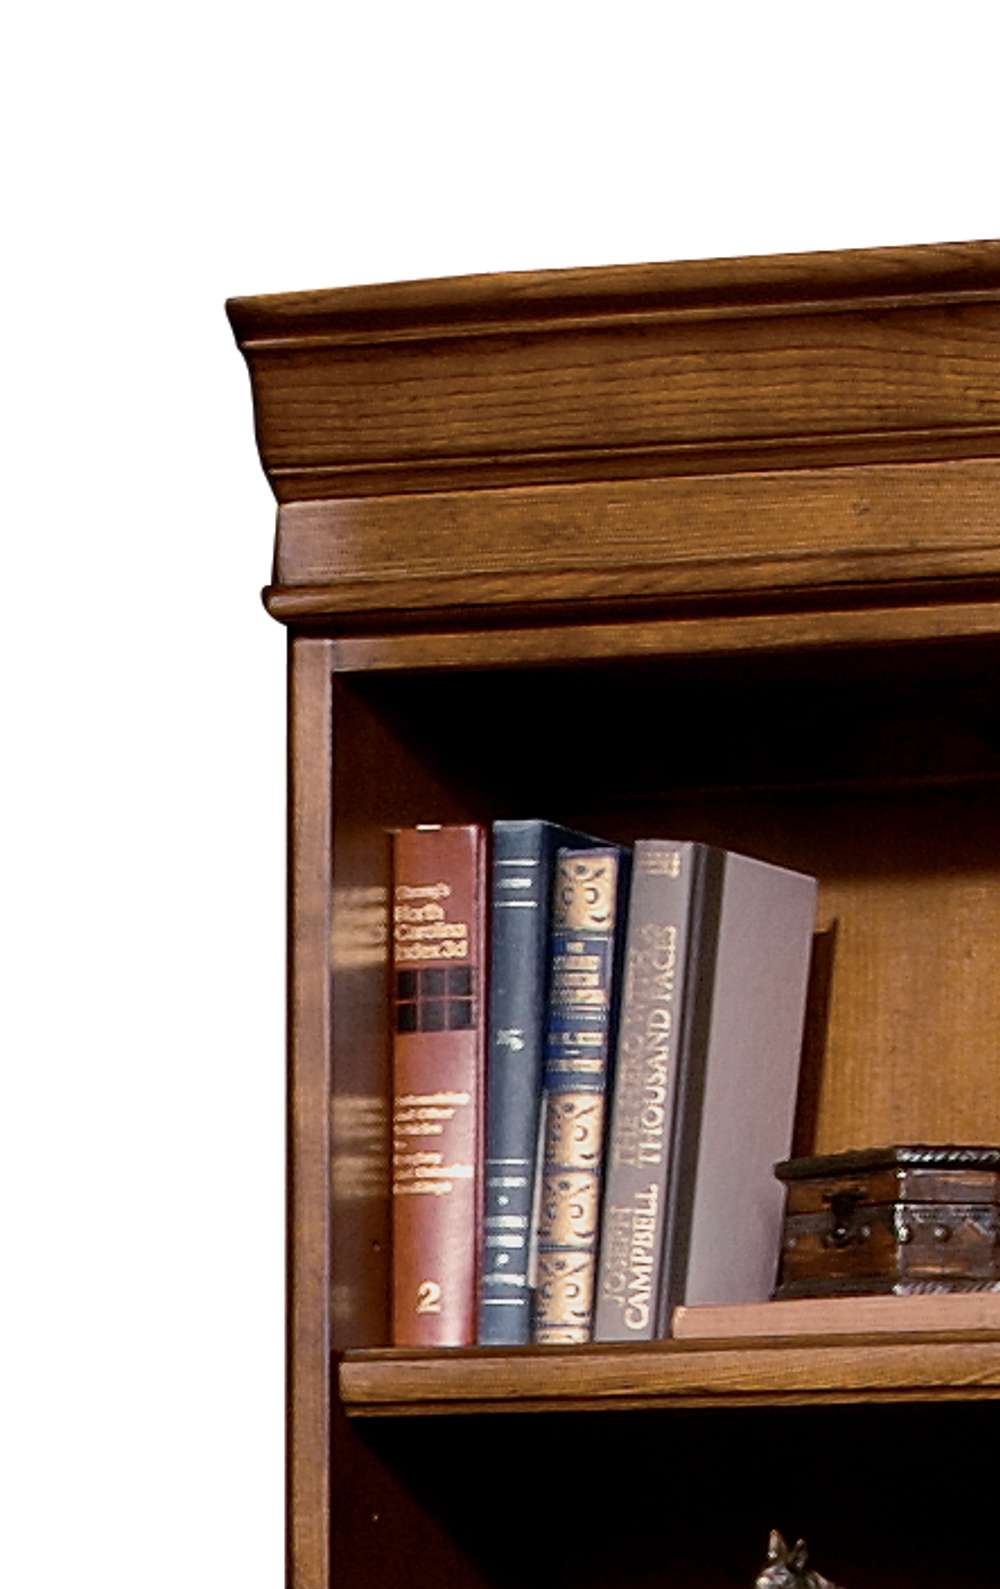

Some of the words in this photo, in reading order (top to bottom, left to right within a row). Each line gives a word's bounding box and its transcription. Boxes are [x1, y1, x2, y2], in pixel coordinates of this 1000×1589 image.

[649, 925, 678, 1000] FACES
[636, 1010, 673, 1167] THOUSAND
[416, 1281, 442, 1314] 2
[624, 1183, 660, 1330] CAMPBELL
